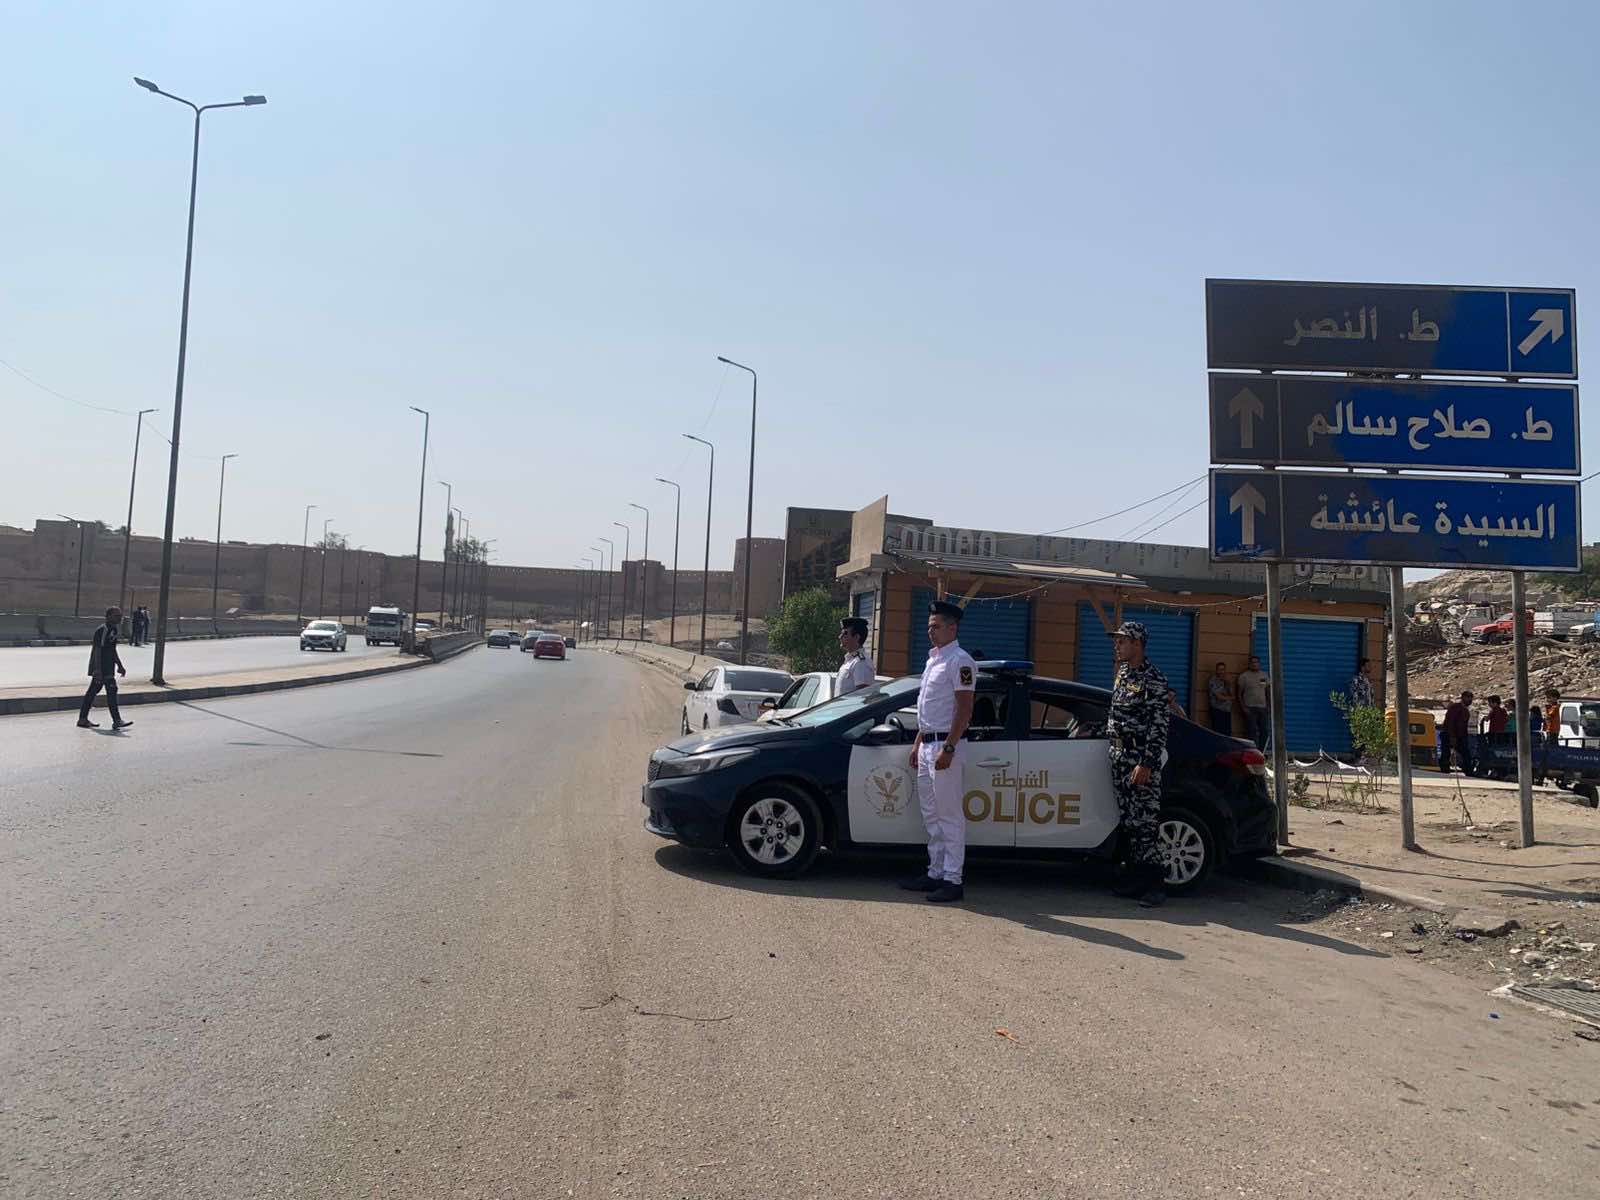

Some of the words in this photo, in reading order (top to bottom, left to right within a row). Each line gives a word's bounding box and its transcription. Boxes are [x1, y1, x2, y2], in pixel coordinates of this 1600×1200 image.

[1283, 304, 1378, 346] النصر
[1307, 400, 1398, 447] سالم
[1406, 403, 1492, 450] صلاح
[1309, 492, 1421, 534] عائشة
[1434, 501, 1556, 547] السيدة
[991, 768, 1049, 791] الشرطة
[962, 789, 1081, 825] OLICE
